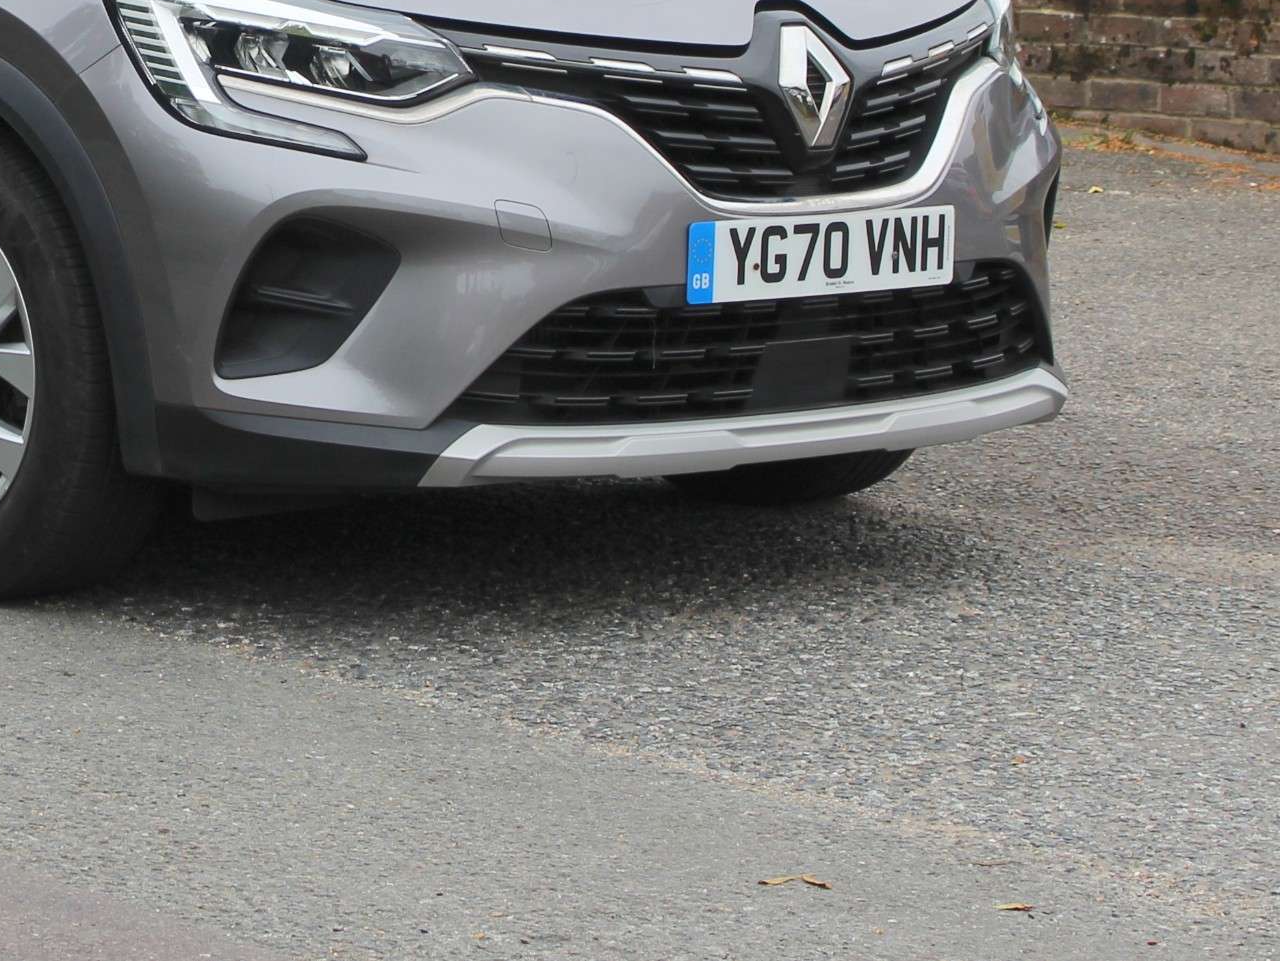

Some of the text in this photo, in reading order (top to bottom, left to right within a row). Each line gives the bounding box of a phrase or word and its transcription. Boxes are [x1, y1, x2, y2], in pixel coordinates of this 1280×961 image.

[729, 221, 850, 286] YG70
[865, 214, 946, 276] VNH
[692, 273, 710, 289] GB
